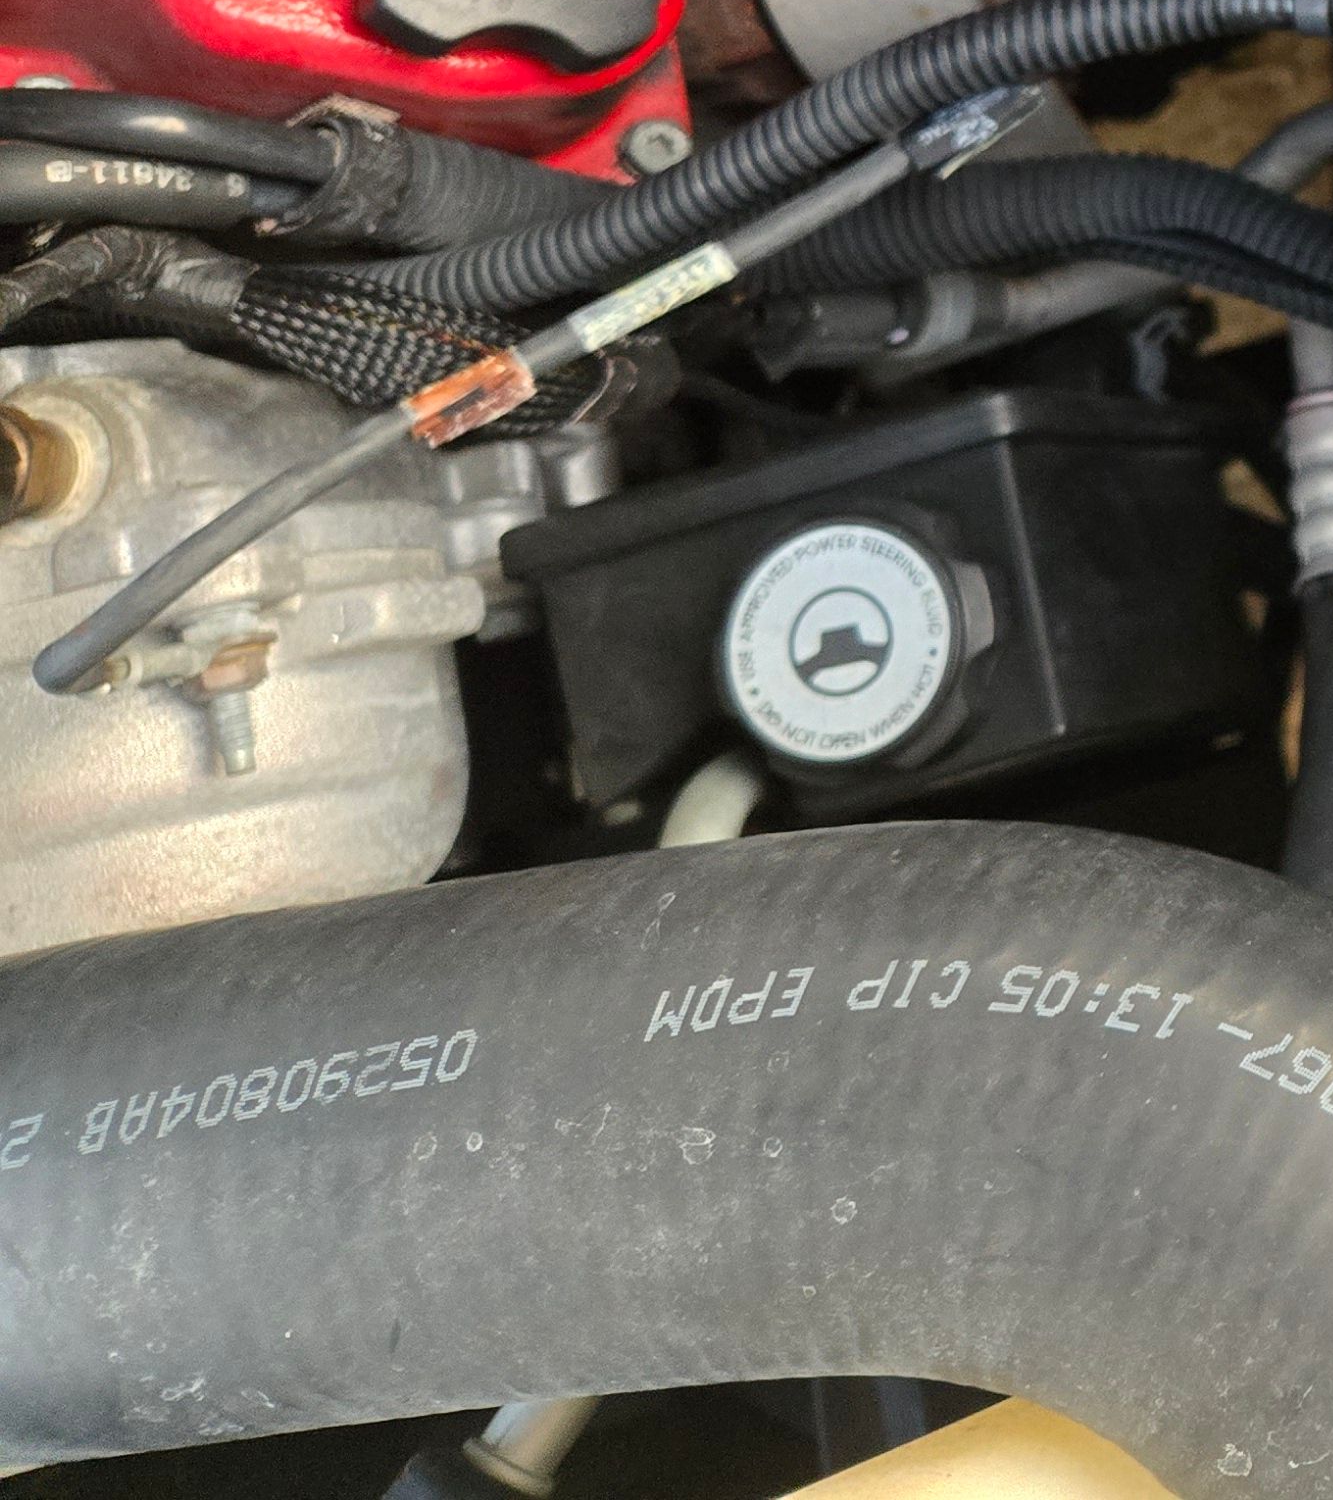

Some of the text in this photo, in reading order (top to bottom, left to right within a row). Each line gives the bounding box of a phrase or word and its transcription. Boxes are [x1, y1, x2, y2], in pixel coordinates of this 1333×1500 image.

[793, 533, 858, 564] POWER
[860, 535, 926, 588] STEERING
[643, 964, 813, 1043] EPDM
[847, 960, 970, 1013] CIP
[987, 963, 1194, 1040] 13:05
[78, 1029, 480, 1155] 05290804AB
